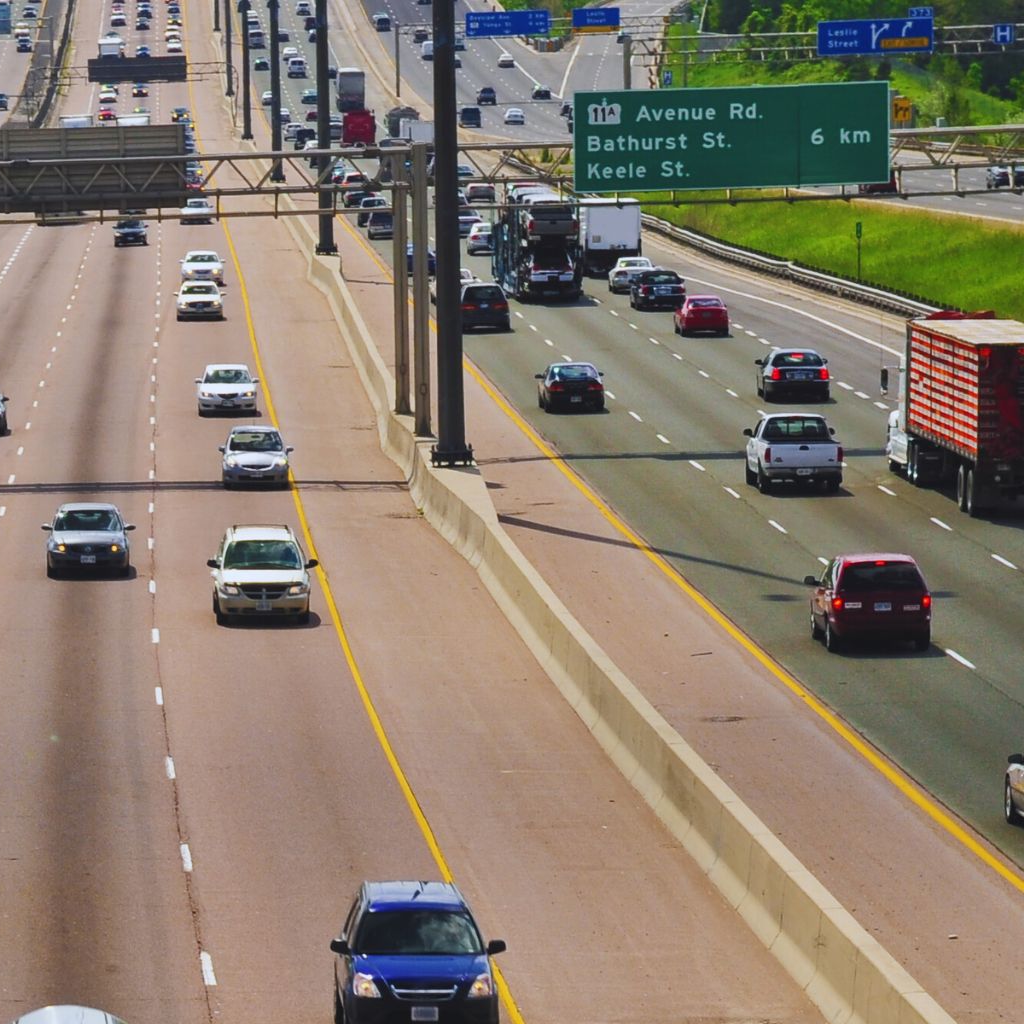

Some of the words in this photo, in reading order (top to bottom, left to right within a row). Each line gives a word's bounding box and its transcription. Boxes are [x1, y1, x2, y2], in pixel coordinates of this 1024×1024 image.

[911, 8, 931, 17] 373
[827, 28, 859, 37] Leslie
[996, 26, 1011, 42] H
[827, 40, 859, 49] Street
[591, 106, 617, 123] 11A
[635, 105, 717, 123] Avenue
[729, 102, 764, 121] Rd.
[587, 132, 688, 153] Bathurst
[702, 131, 733, 149] St.
[810, 128, 824, 146] 6
[839, 128, 871, 145] km
[587, 162, 647, 180] Keele
[660, 160, 691, 178] St.
